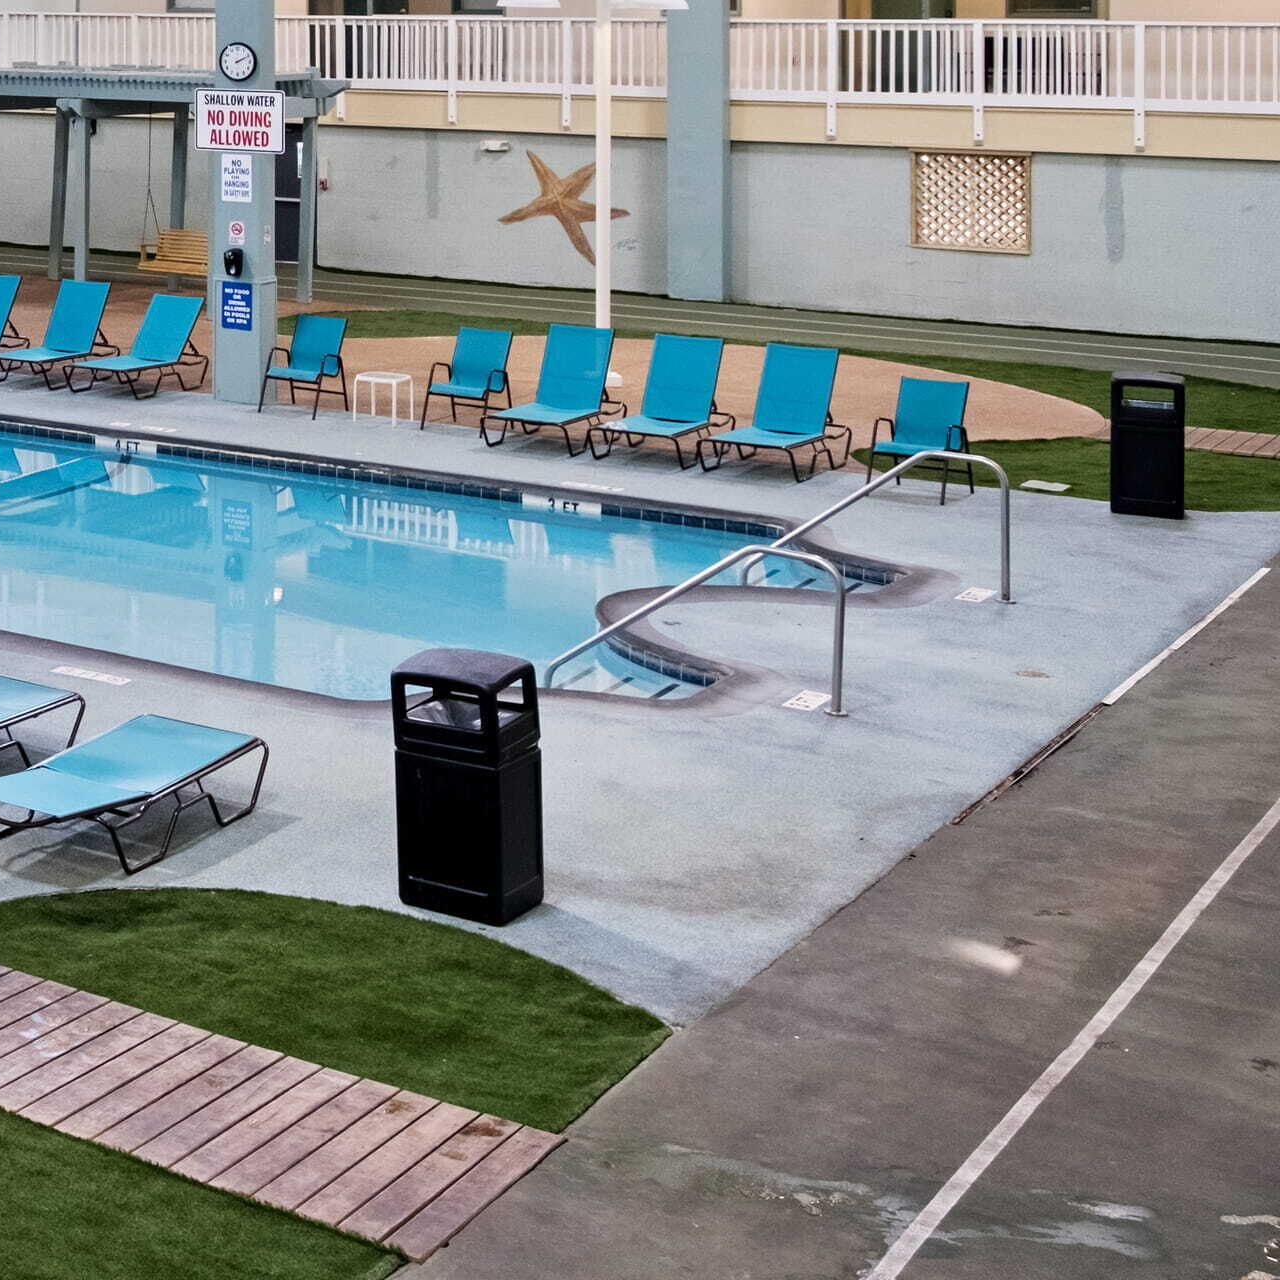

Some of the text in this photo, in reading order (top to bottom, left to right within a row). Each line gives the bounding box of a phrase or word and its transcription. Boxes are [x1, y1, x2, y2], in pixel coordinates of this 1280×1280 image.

[204, 94, 275, 107] SHALLOW WATER
[207, 110, 272, 128] NO DIVING
[210, 129, 269, 147] ALLOWED
[224, 167, 249, 175] PLAYING
[224, 180, 249, 189] HANGING
[563, 501, 579, 512] FT
